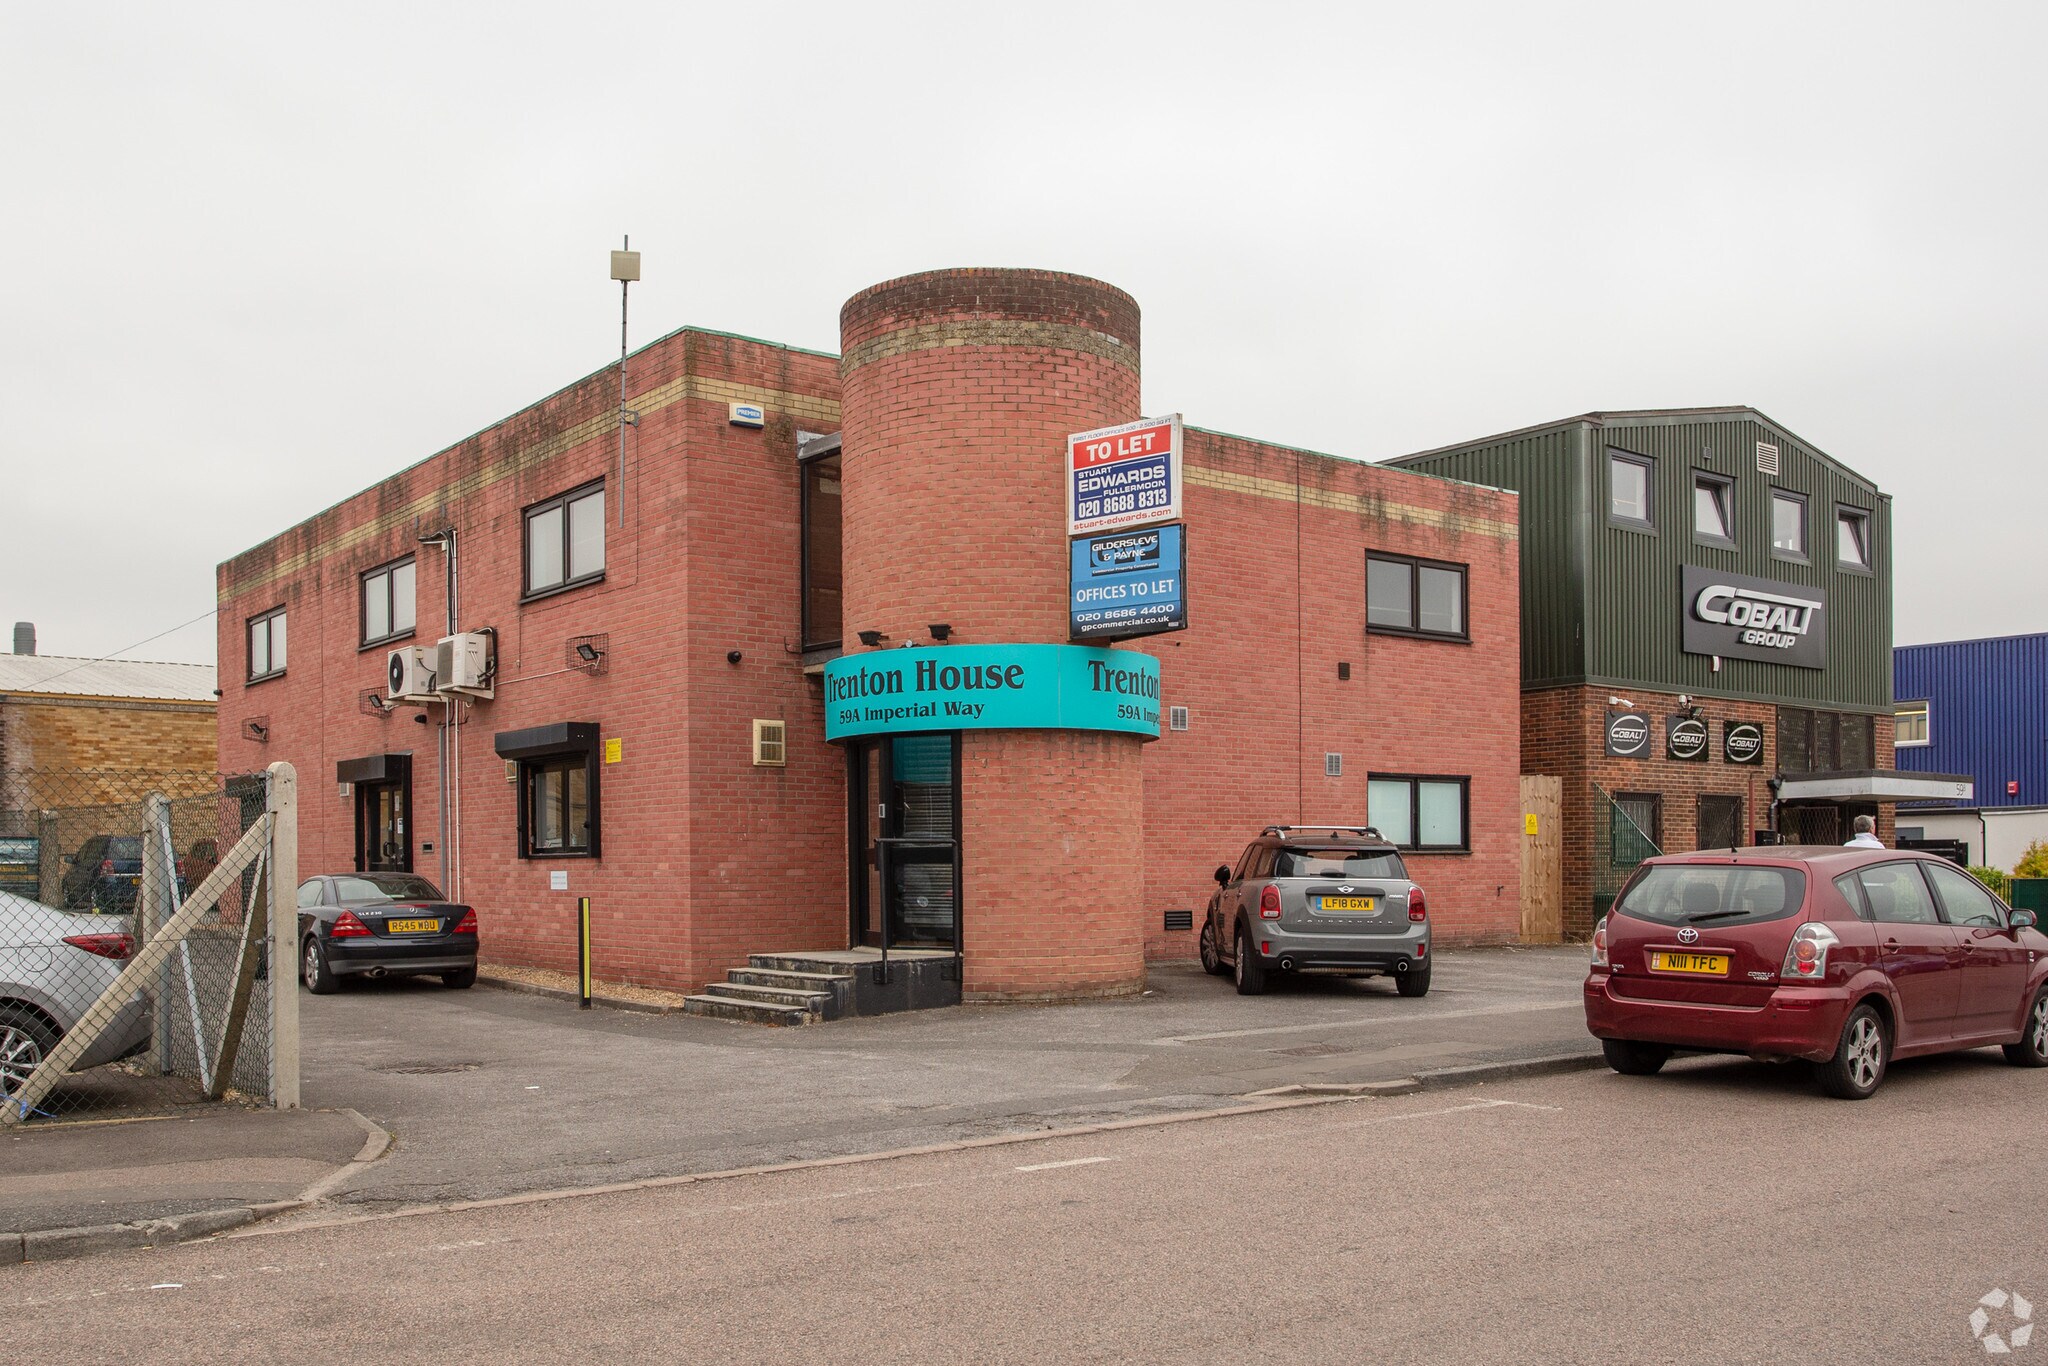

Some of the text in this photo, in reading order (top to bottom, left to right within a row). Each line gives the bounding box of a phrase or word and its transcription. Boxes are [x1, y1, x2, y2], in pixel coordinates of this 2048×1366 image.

[1104, 427, 1125, 436] OFFICES
[1086, 432, 1156, 462] TO LET
[1078, 466, 1112, 479] STUART
[1078, 465, 1166, 493] EDWARDS
[1103, 479, 1166, 497] FULLERMOON
[1078, 488, 1167, 519] 020 8688 8313
[1073, 508, 1172, 530] stuart-edwards.com
[1091, 535, 1158, 552] GILDERSLEVE
[1103, 548, 1146, 562] & PAYNE
[1076, 579, 1175, 603] OFFICES TO LET
[1076, 604, 1175, 622] 020 8686 4400
[1695, 584, 1822, 635] COBALT
[1081, 616, 1170, 632] gpcommercial.co.uk
[1743, 630, 1796, 649] GROUP
[827, 659, 1025, 703] Trenton House
[1087, 659, 1159, 700] Trenton
[839, 701, 985, 725] 59A Imperial Way
[1117, 704, 1141, 720] 59A
[1611, 727, 1646, 740] COBALT
[1672, 732, 1705, 744] COBALT
[1729, 737, 1760, 748] COBALT
[1325, 898, 1370, 909] LF18 GXW
[1692, 955, 1718, 971] TFC
